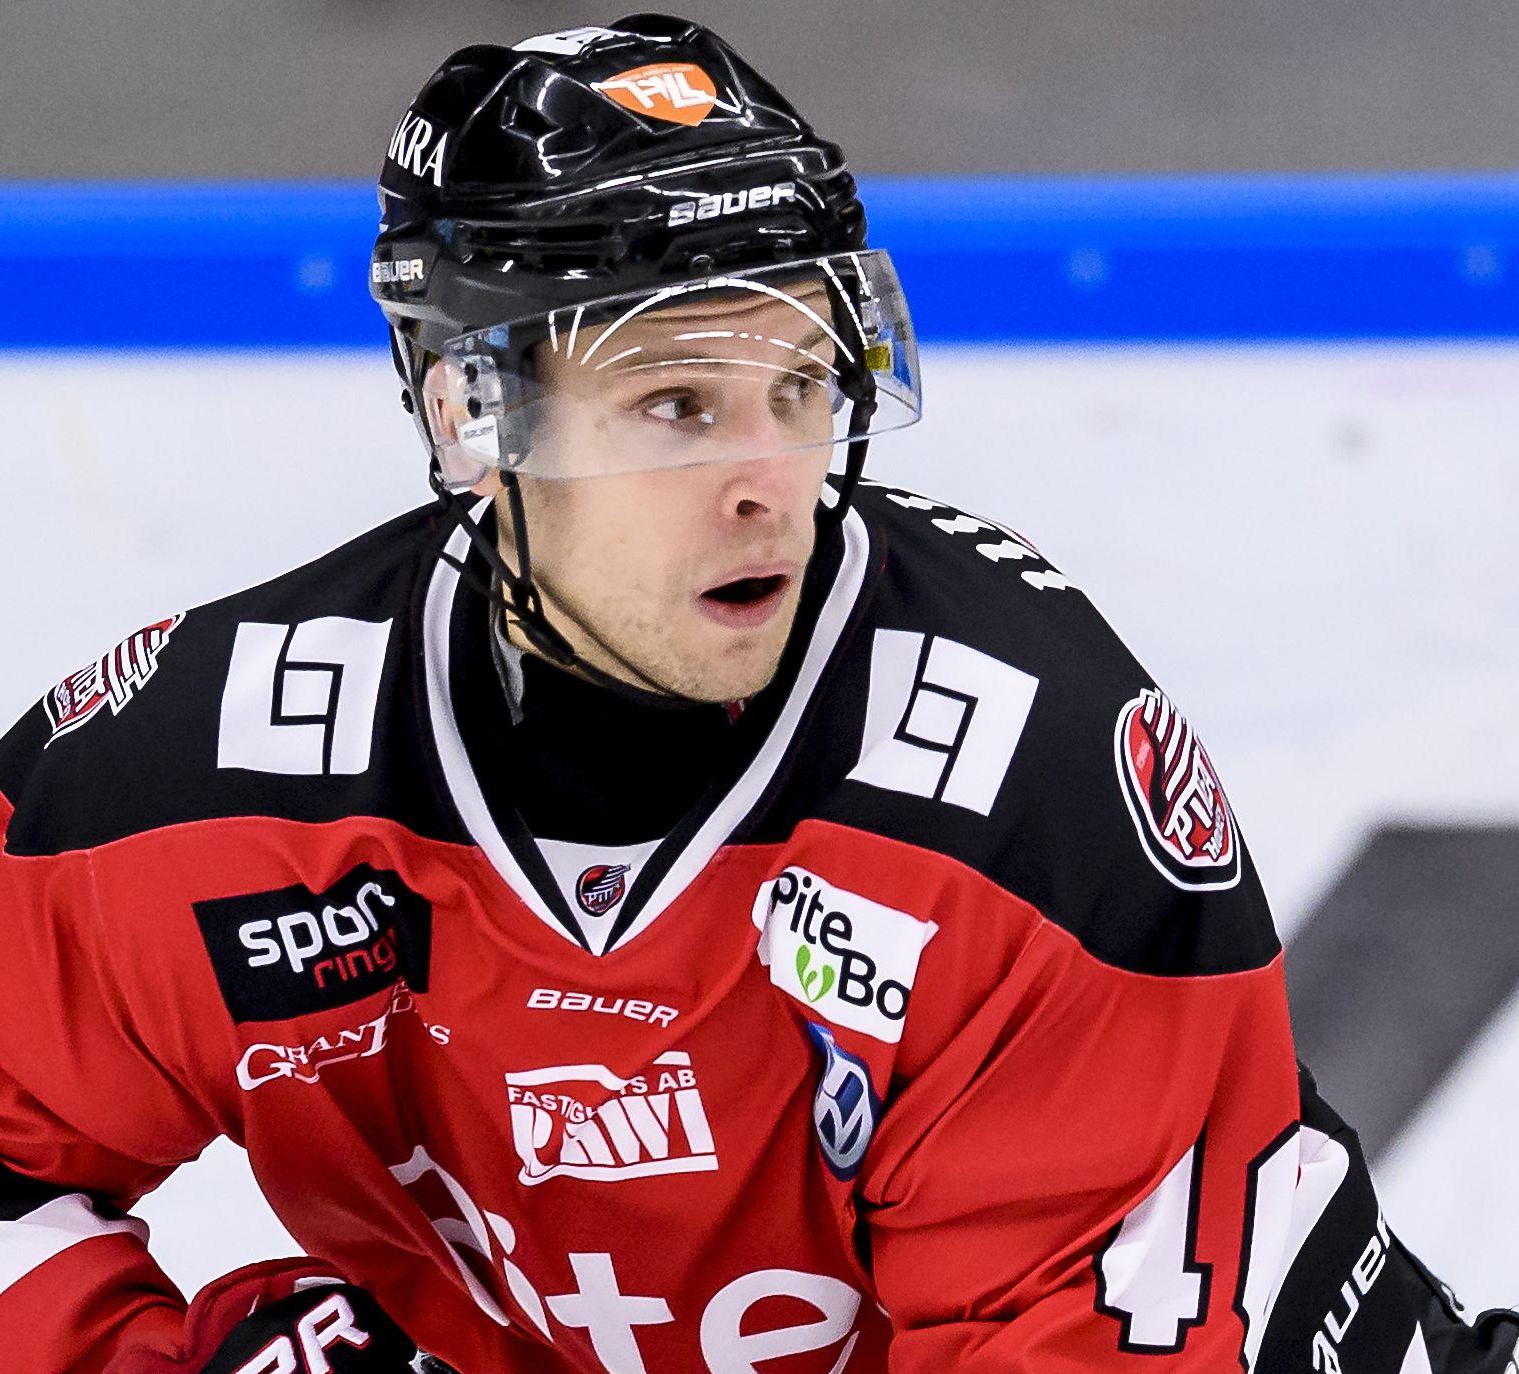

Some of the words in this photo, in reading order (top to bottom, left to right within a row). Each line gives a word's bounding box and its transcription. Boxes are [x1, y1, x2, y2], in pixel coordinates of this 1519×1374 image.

[667, 181, 797, 228] BAUER
[371, 258, 425, 283] BAUER
[526, 988, 680, 1029] BAUER
